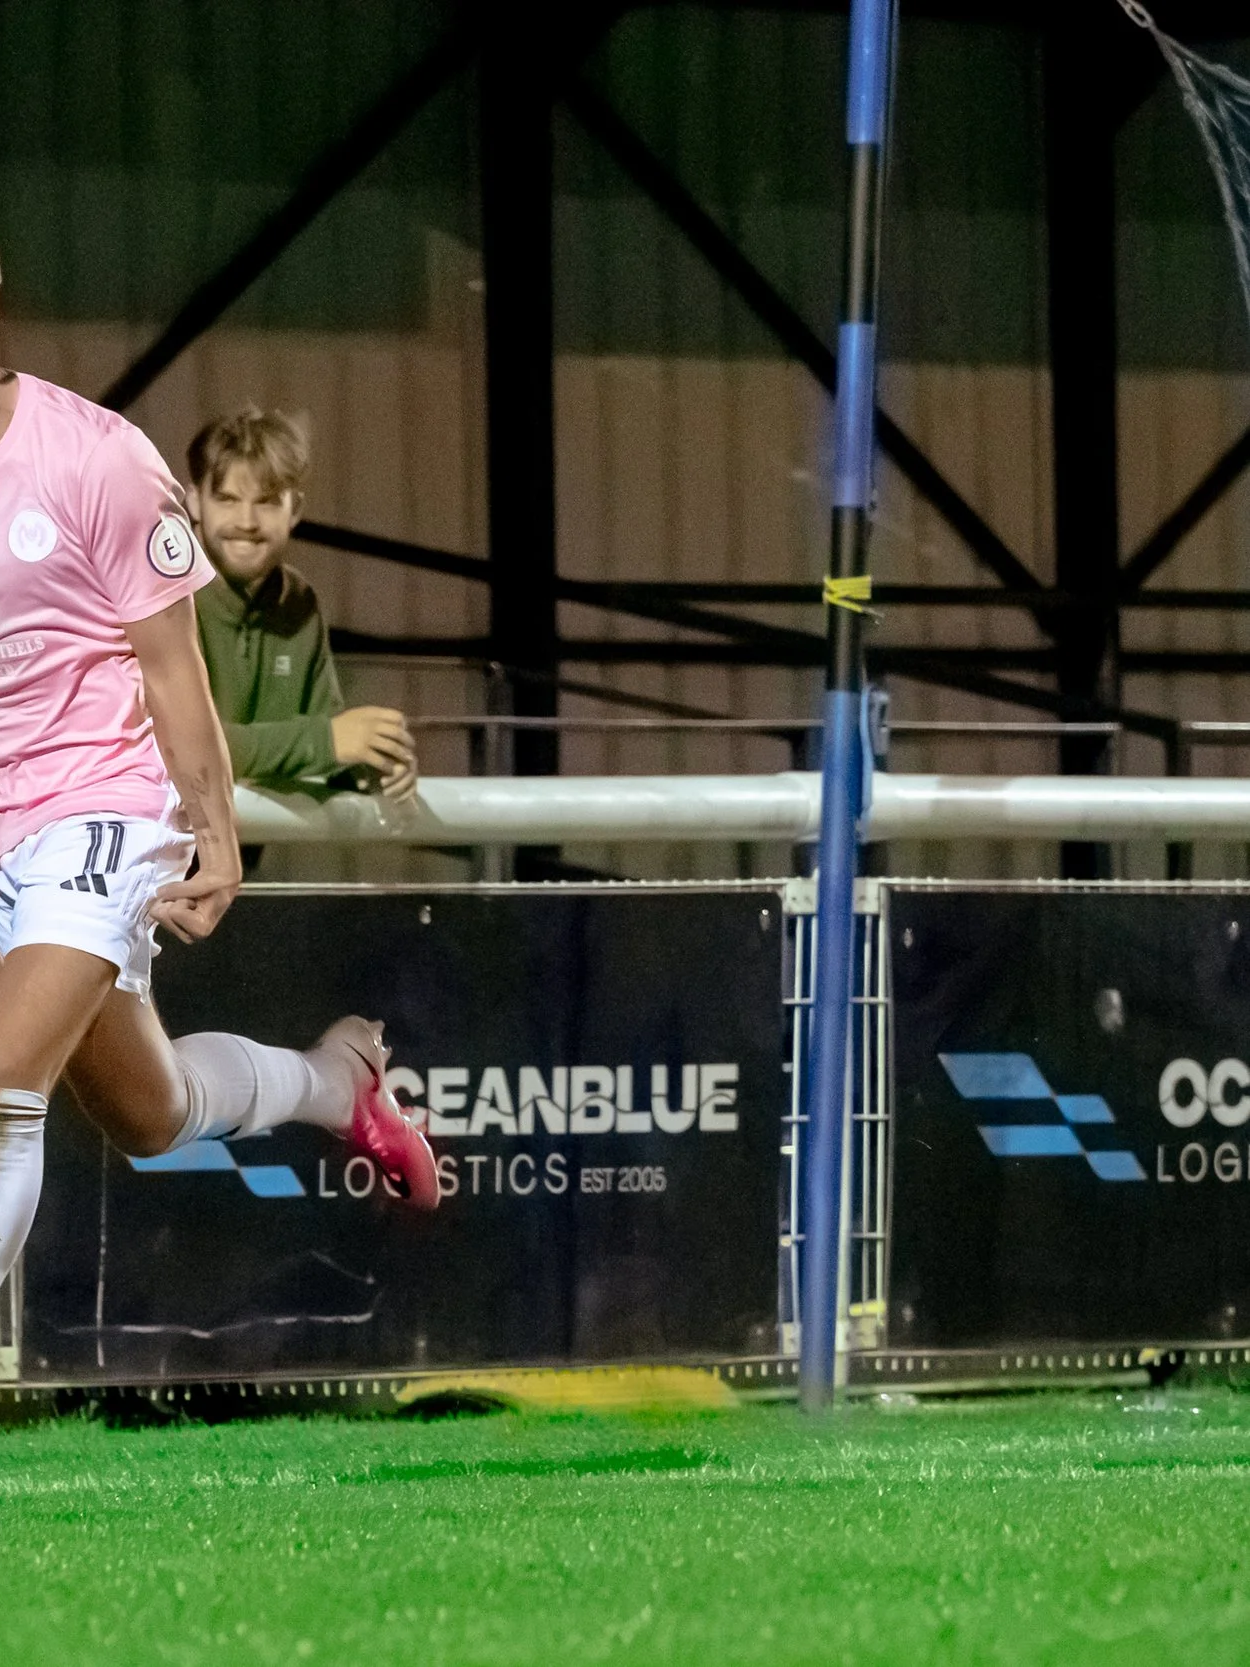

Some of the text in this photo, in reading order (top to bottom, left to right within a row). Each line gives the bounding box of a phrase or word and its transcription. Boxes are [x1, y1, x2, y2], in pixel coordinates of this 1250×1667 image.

[83, 821, 125, 874] 11
[385, 1063, 739, 1136] CEANBLUE
[319, 1153, 569, 1198] LOSTICS
[580, 1167, 615, 1193] EST
